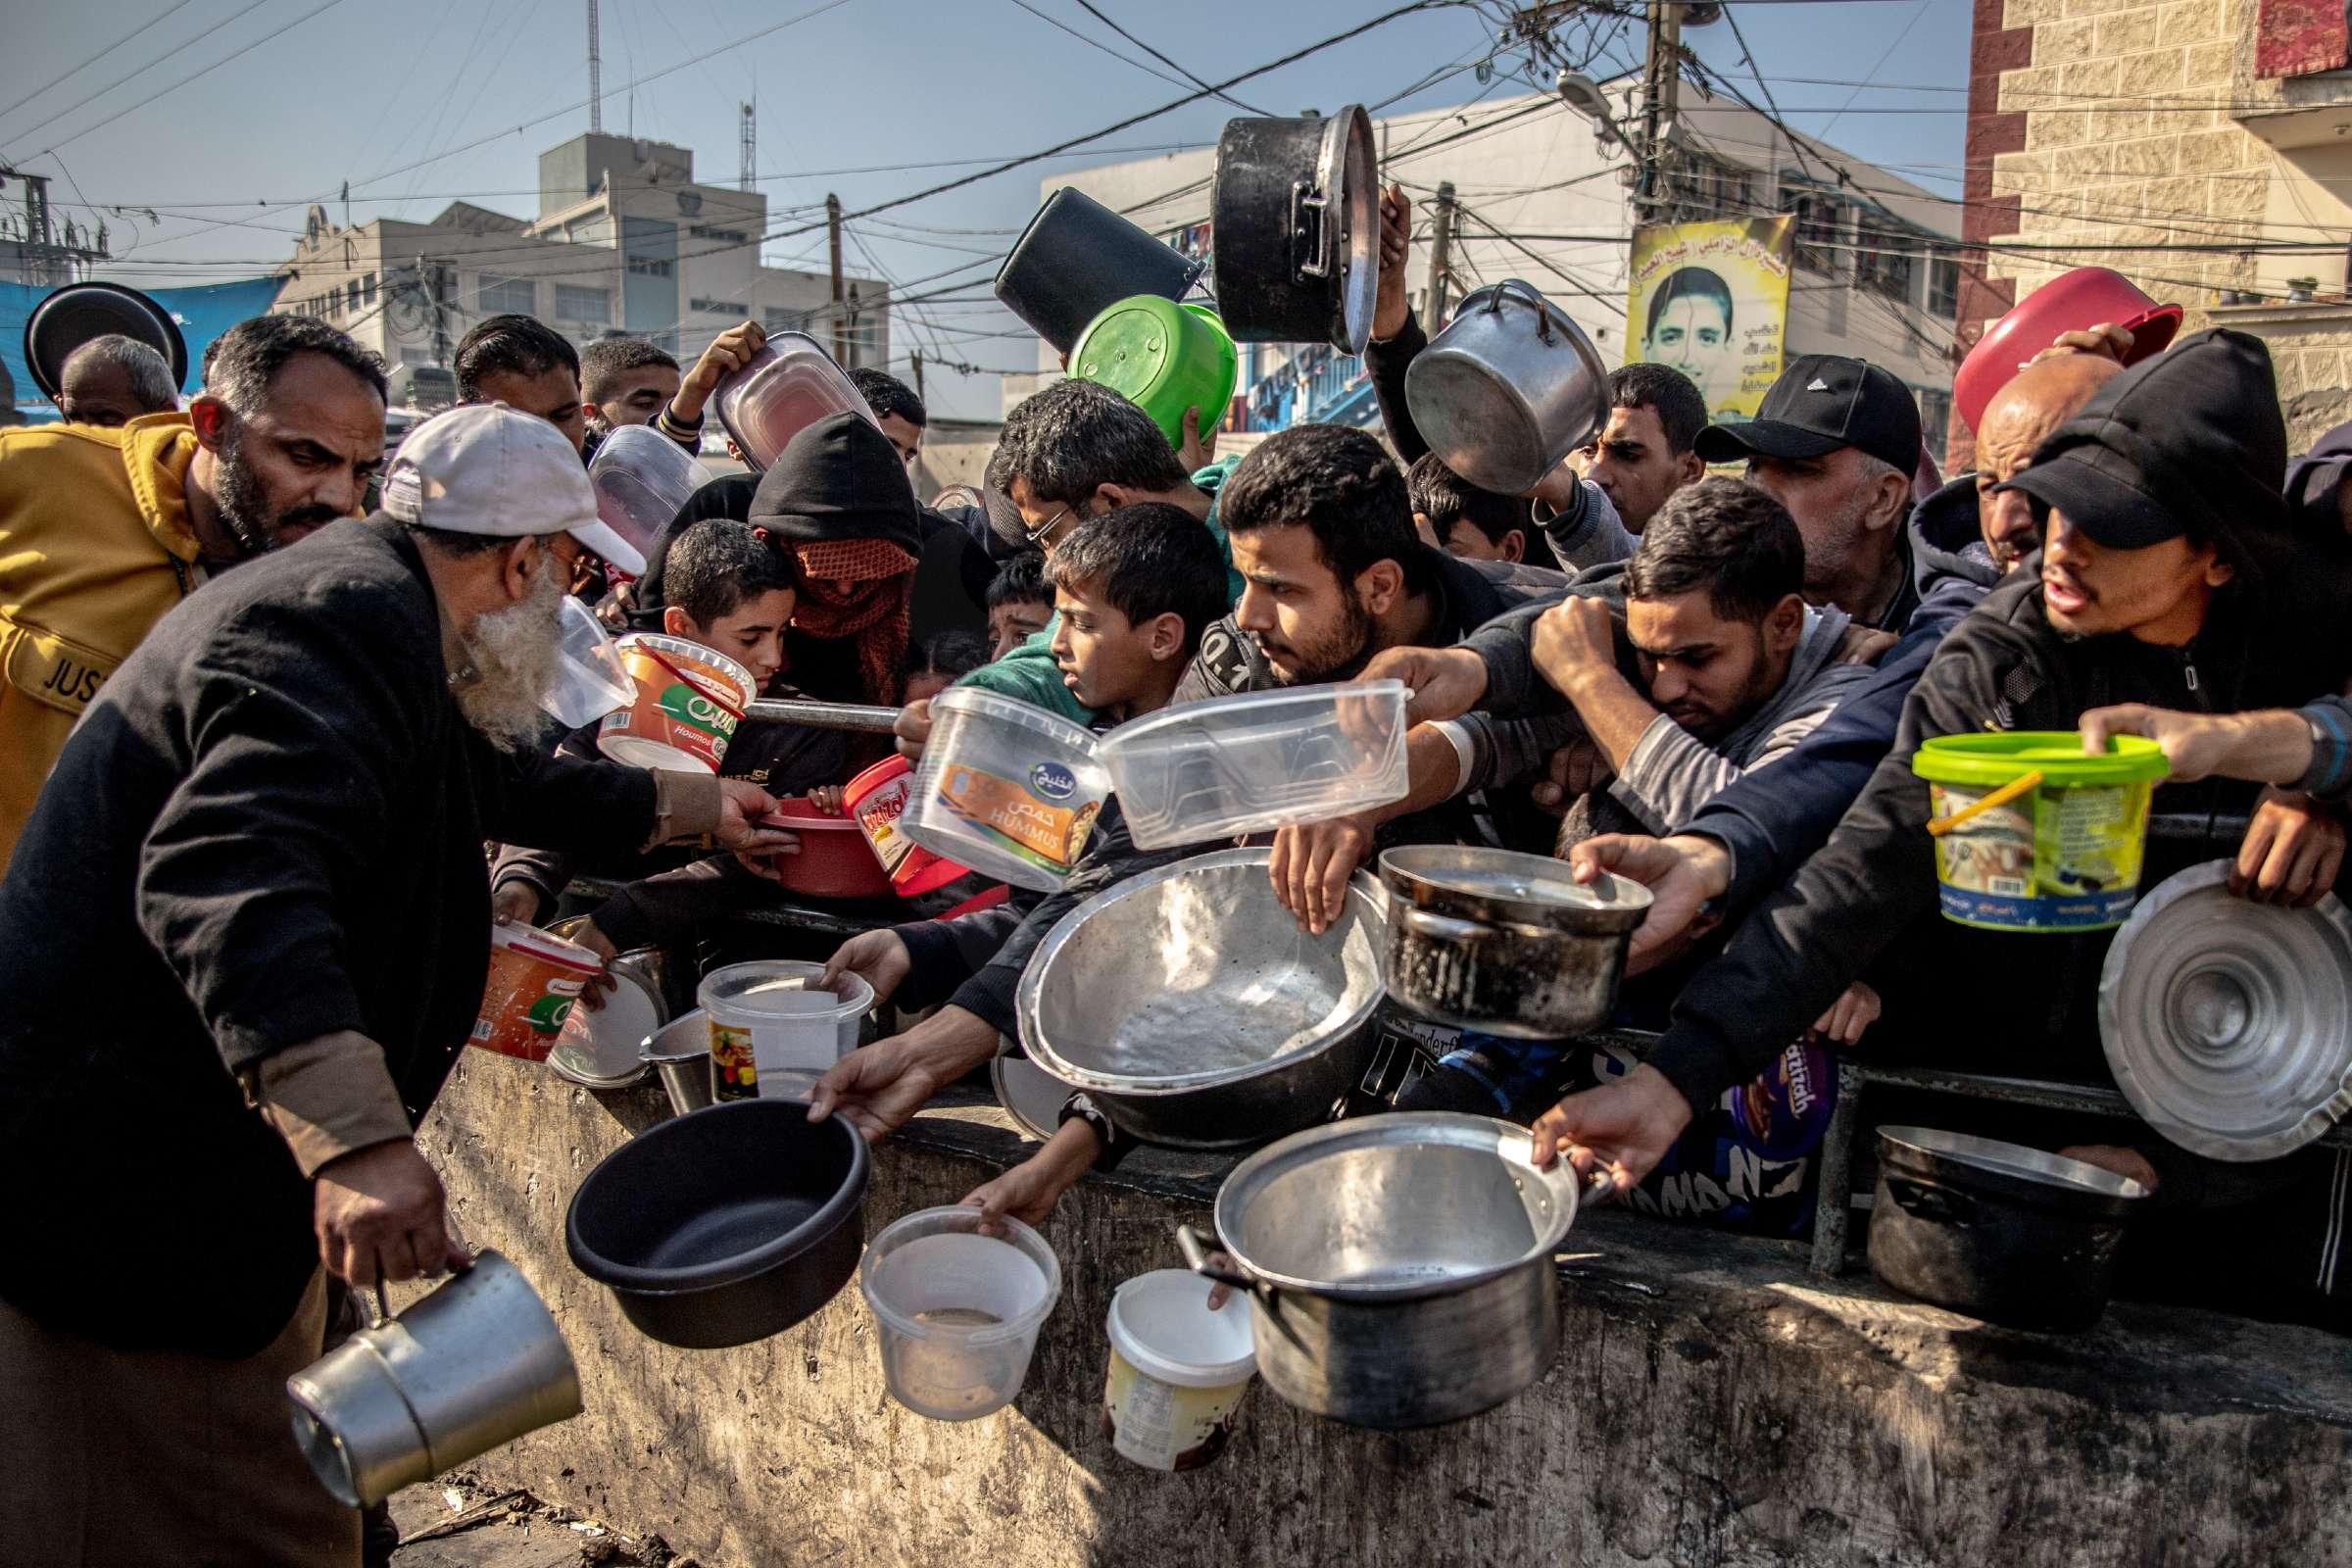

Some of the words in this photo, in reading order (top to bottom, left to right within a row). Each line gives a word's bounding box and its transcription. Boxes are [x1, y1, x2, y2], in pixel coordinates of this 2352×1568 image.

[44, 659, 108, 703] JUS
[990, 808, 1059, 851] HUMMUS
[1007, 799, 1055, 828] حمص
[1784, 1035, 1817, 1116] azizah
